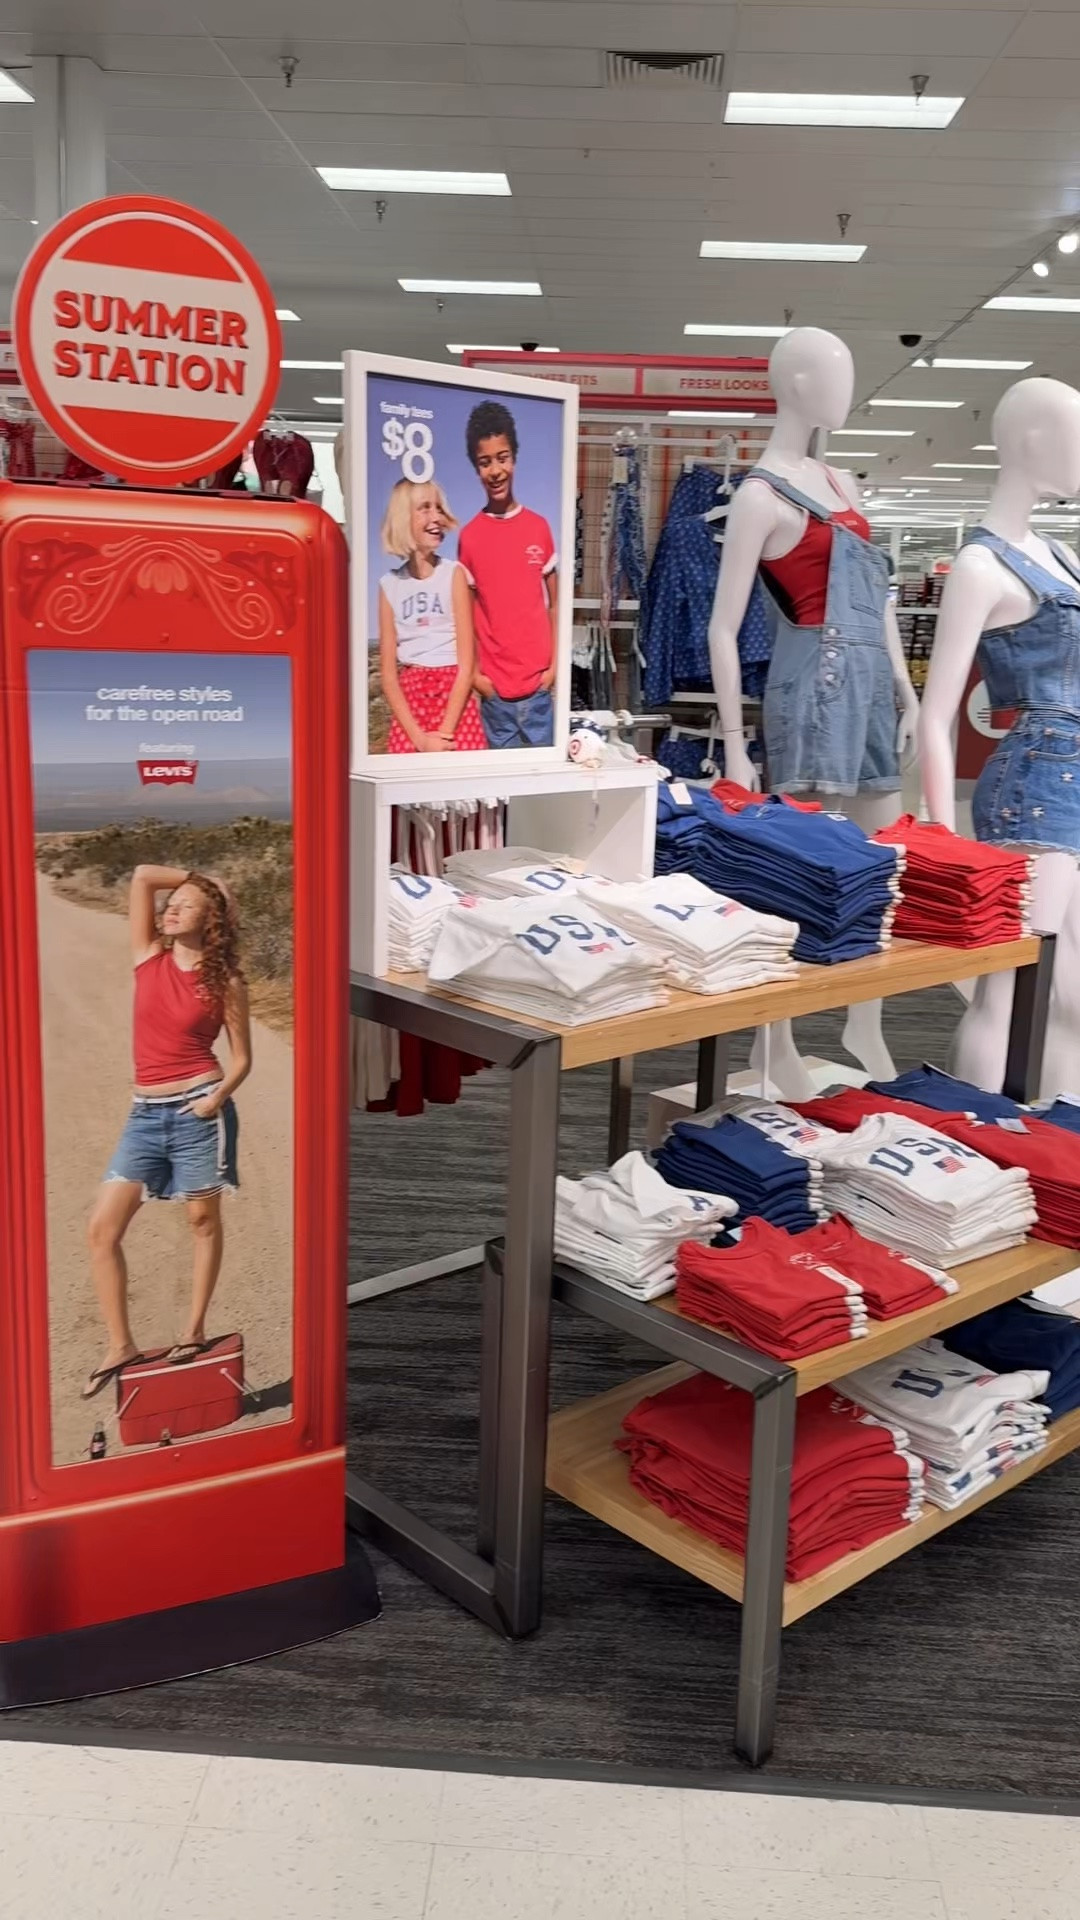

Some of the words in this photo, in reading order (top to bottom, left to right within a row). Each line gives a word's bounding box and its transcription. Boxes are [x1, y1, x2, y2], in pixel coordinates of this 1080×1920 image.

[54, 290, 249, 349] SUMMER
[54, 340, 247, 396] STATION
[569, 374, 598, 386] FITS
[680, 378, 721, 390] FRESH
[724, 379, 769, 391] LOOKS
[380, 401, 410, 419] family
[411, 406, 434, 419] tees
[381, 417, 435, 484] $8
[401, 591, 444, 620] USA
[96, 684, 176, 701] carefree
[178, 686, 233, 705] styles
[86, 704, 114, 721] for
[116, 705, 148, 721] the
[151, 707, 199, 725] open
[201, 706, 244, 722] road
[139, 742, 195, 756] featuring
